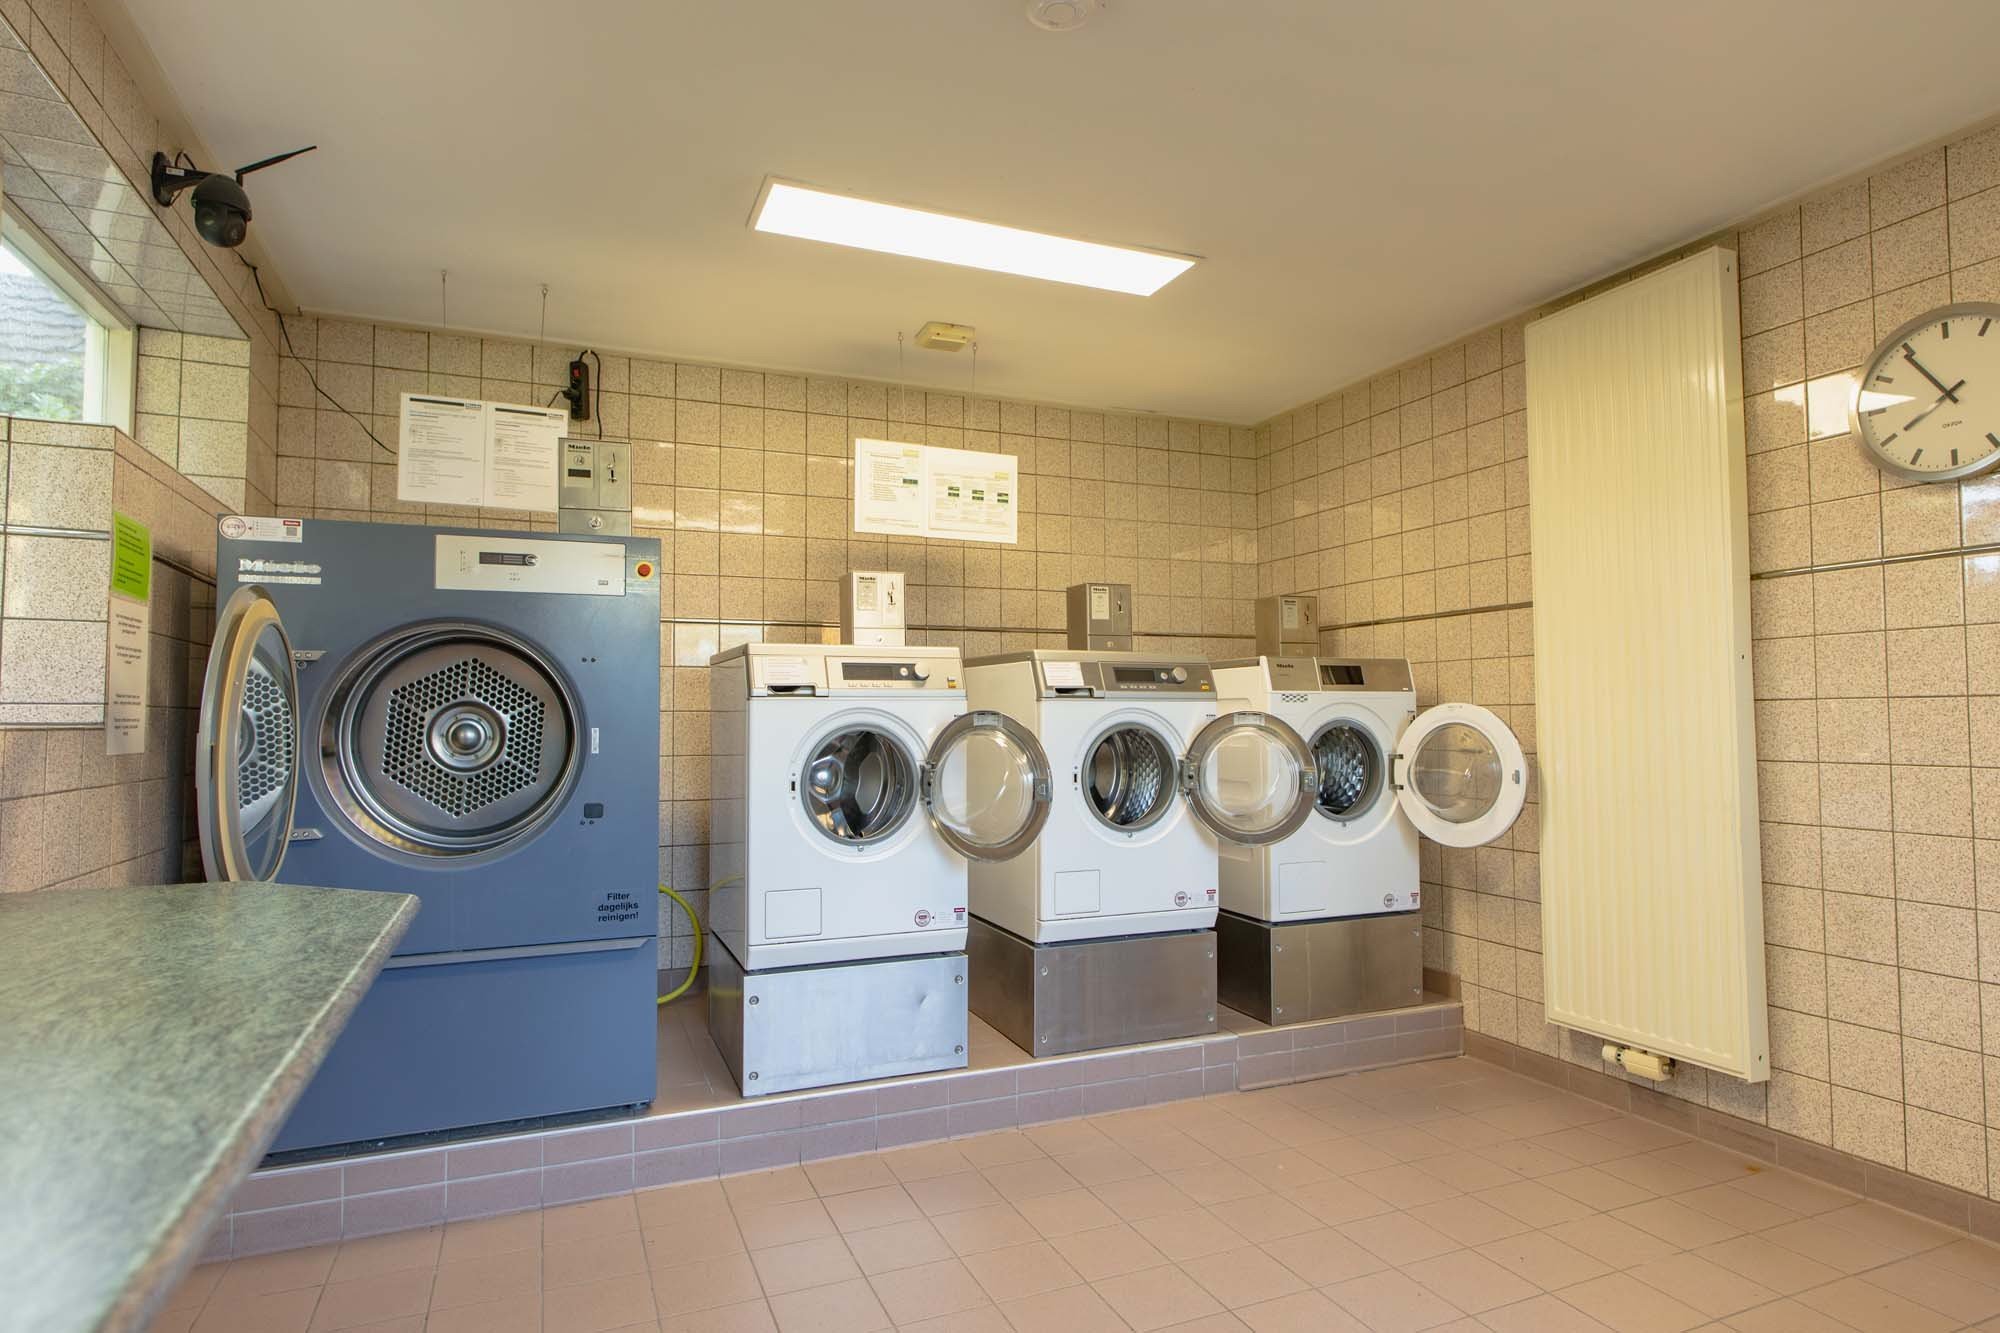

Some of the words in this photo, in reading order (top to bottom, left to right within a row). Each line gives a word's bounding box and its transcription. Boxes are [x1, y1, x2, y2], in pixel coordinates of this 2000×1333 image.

[239, 558, 321, 575] Miele
[607, 893, 630, 901] Filter
[598, 902, 639, 912] dagelijks
[598, 911, 639, 922] reinigen!
